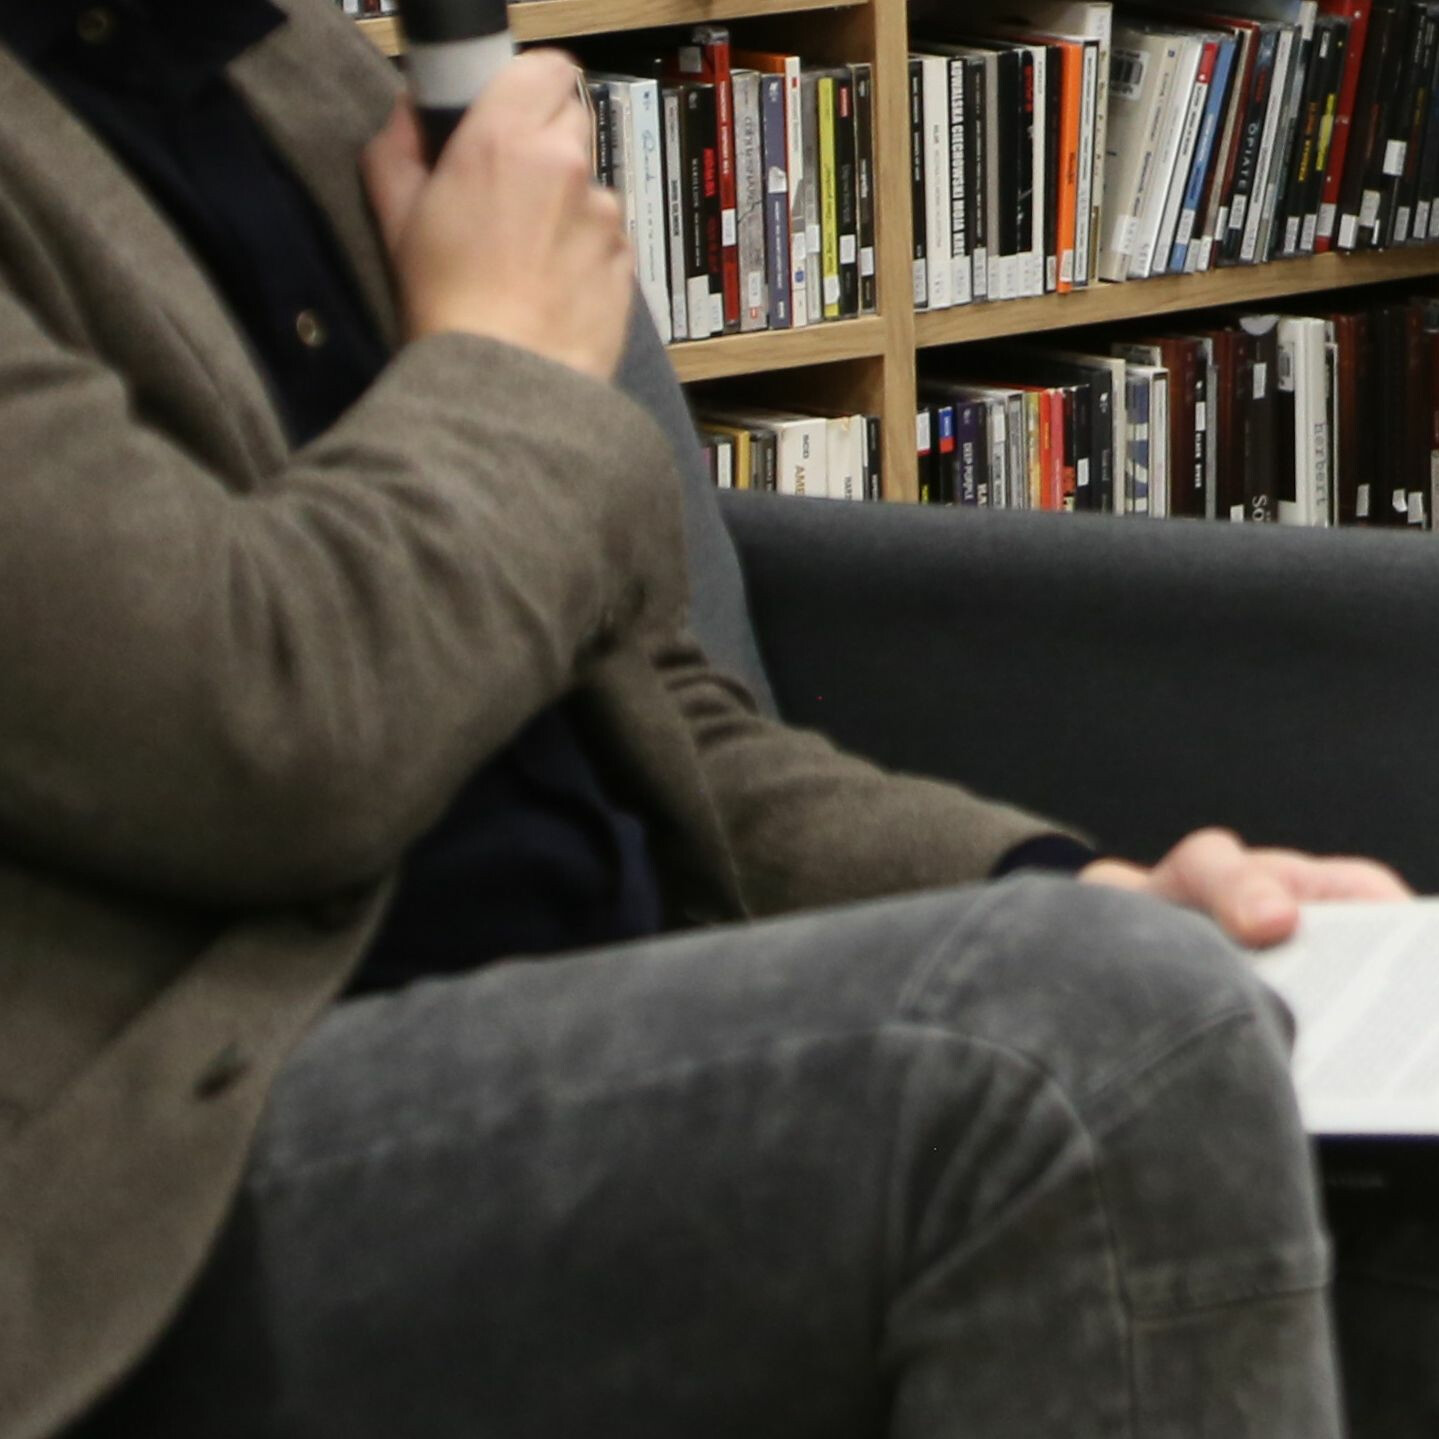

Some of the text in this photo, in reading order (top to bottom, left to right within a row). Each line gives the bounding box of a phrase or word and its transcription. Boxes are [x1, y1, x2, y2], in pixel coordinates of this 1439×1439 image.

[950, 61, 965, 258] KOWALSKA CIECHOWSKI MOJA KRE
[795, 465, 805, 495] AME
[963, 442, 974, 499] DEEP PURPLE
[1314, 423, 1327, 507] herbert
